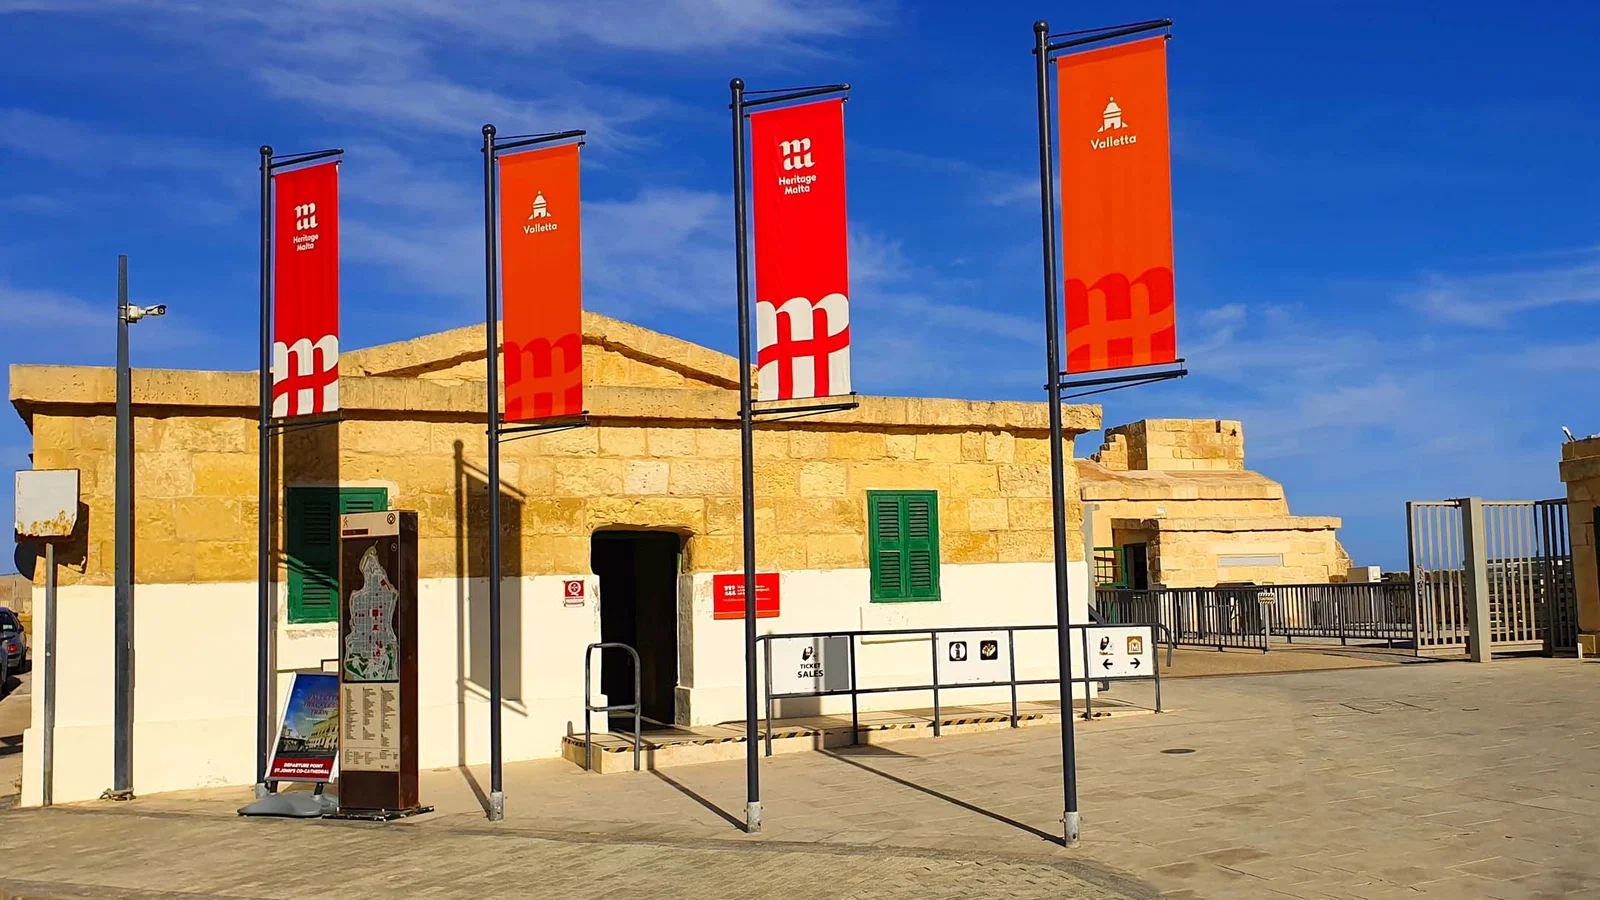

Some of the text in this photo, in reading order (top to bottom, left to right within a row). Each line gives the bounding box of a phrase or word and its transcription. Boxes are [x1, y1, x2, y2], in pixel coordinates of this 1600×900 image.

[1090, 135, 1137, 150] Valletta
[778, 174, 817, 186] Heritage
[784, 184, 811, 195] Malta
[523, 223, 558, 234] Valletta
[293, 233, 319, 244] Heritage
[296, 242, 315, 252] Malta
[800, 662, 821, 670] TICKET
[797, 670, 823, 678] SALES
